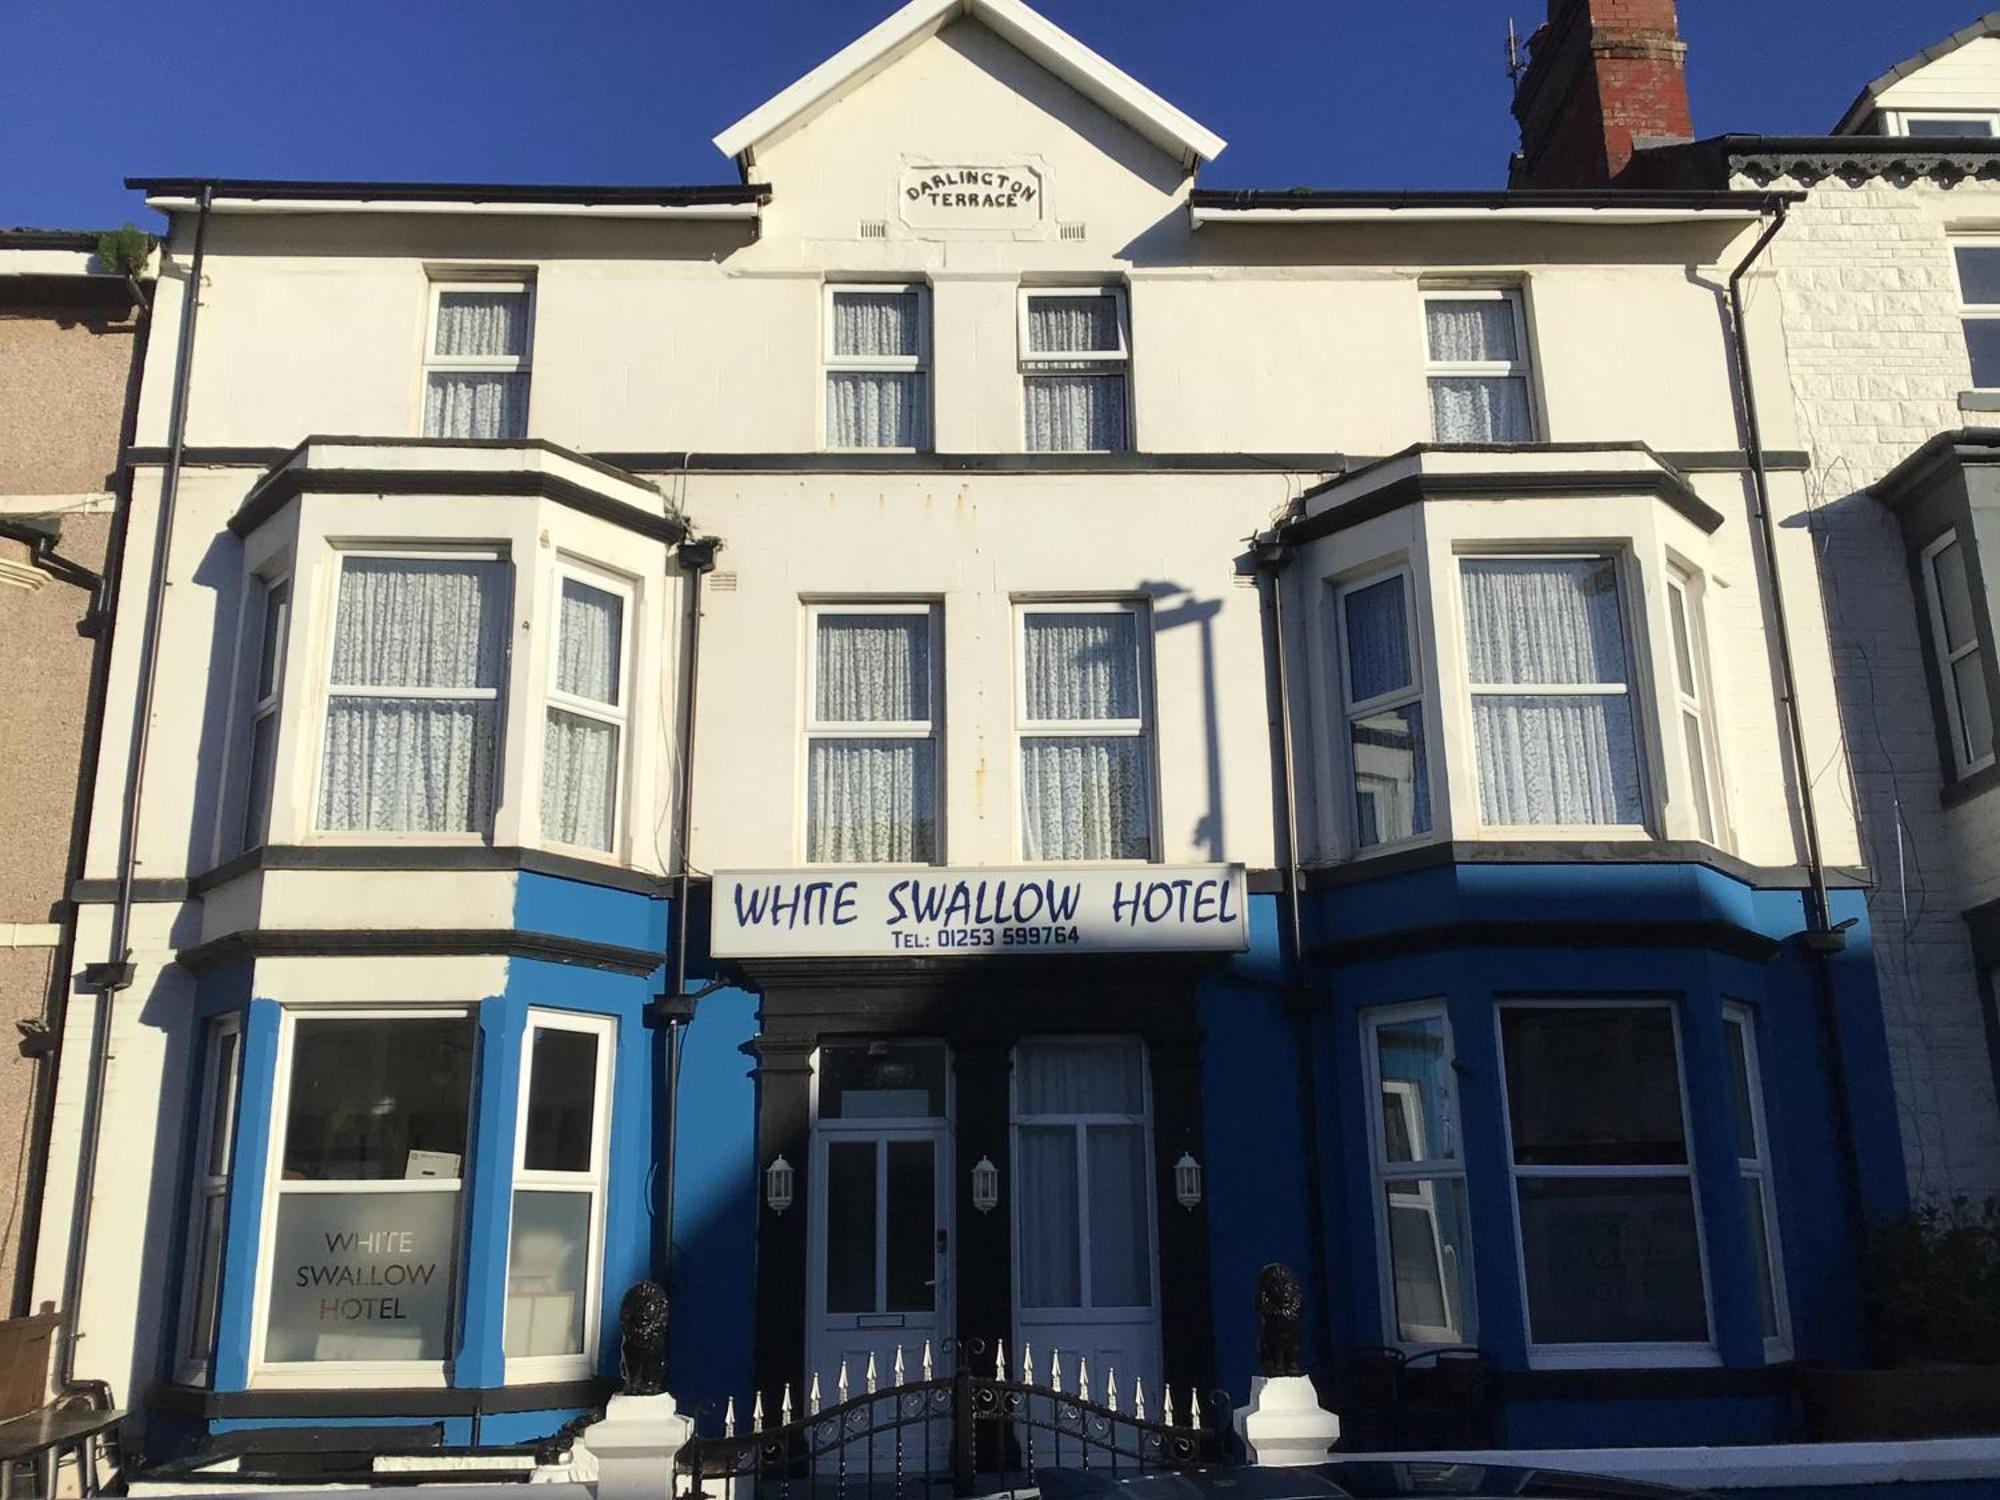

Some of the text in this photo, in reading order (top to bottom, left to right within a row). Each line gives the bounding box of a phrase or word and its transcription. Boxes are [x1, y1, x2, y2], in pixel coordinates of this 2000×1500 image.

[906, 171, 1036, 201] DARLINGTON
[928, 193, 1018, 207] TERRACE
[734, 879, 1237, 930] WHITE SWALLOW HOTEL
[938, 928, 994, 947] 01253
[1002, 926, 1079, 946] 599764
[325, 1232, 413, 1254] WHITE
[297, 1264, 436, 1287] SWALLOW
[320, 1298, 406, 1320] HOTEL
